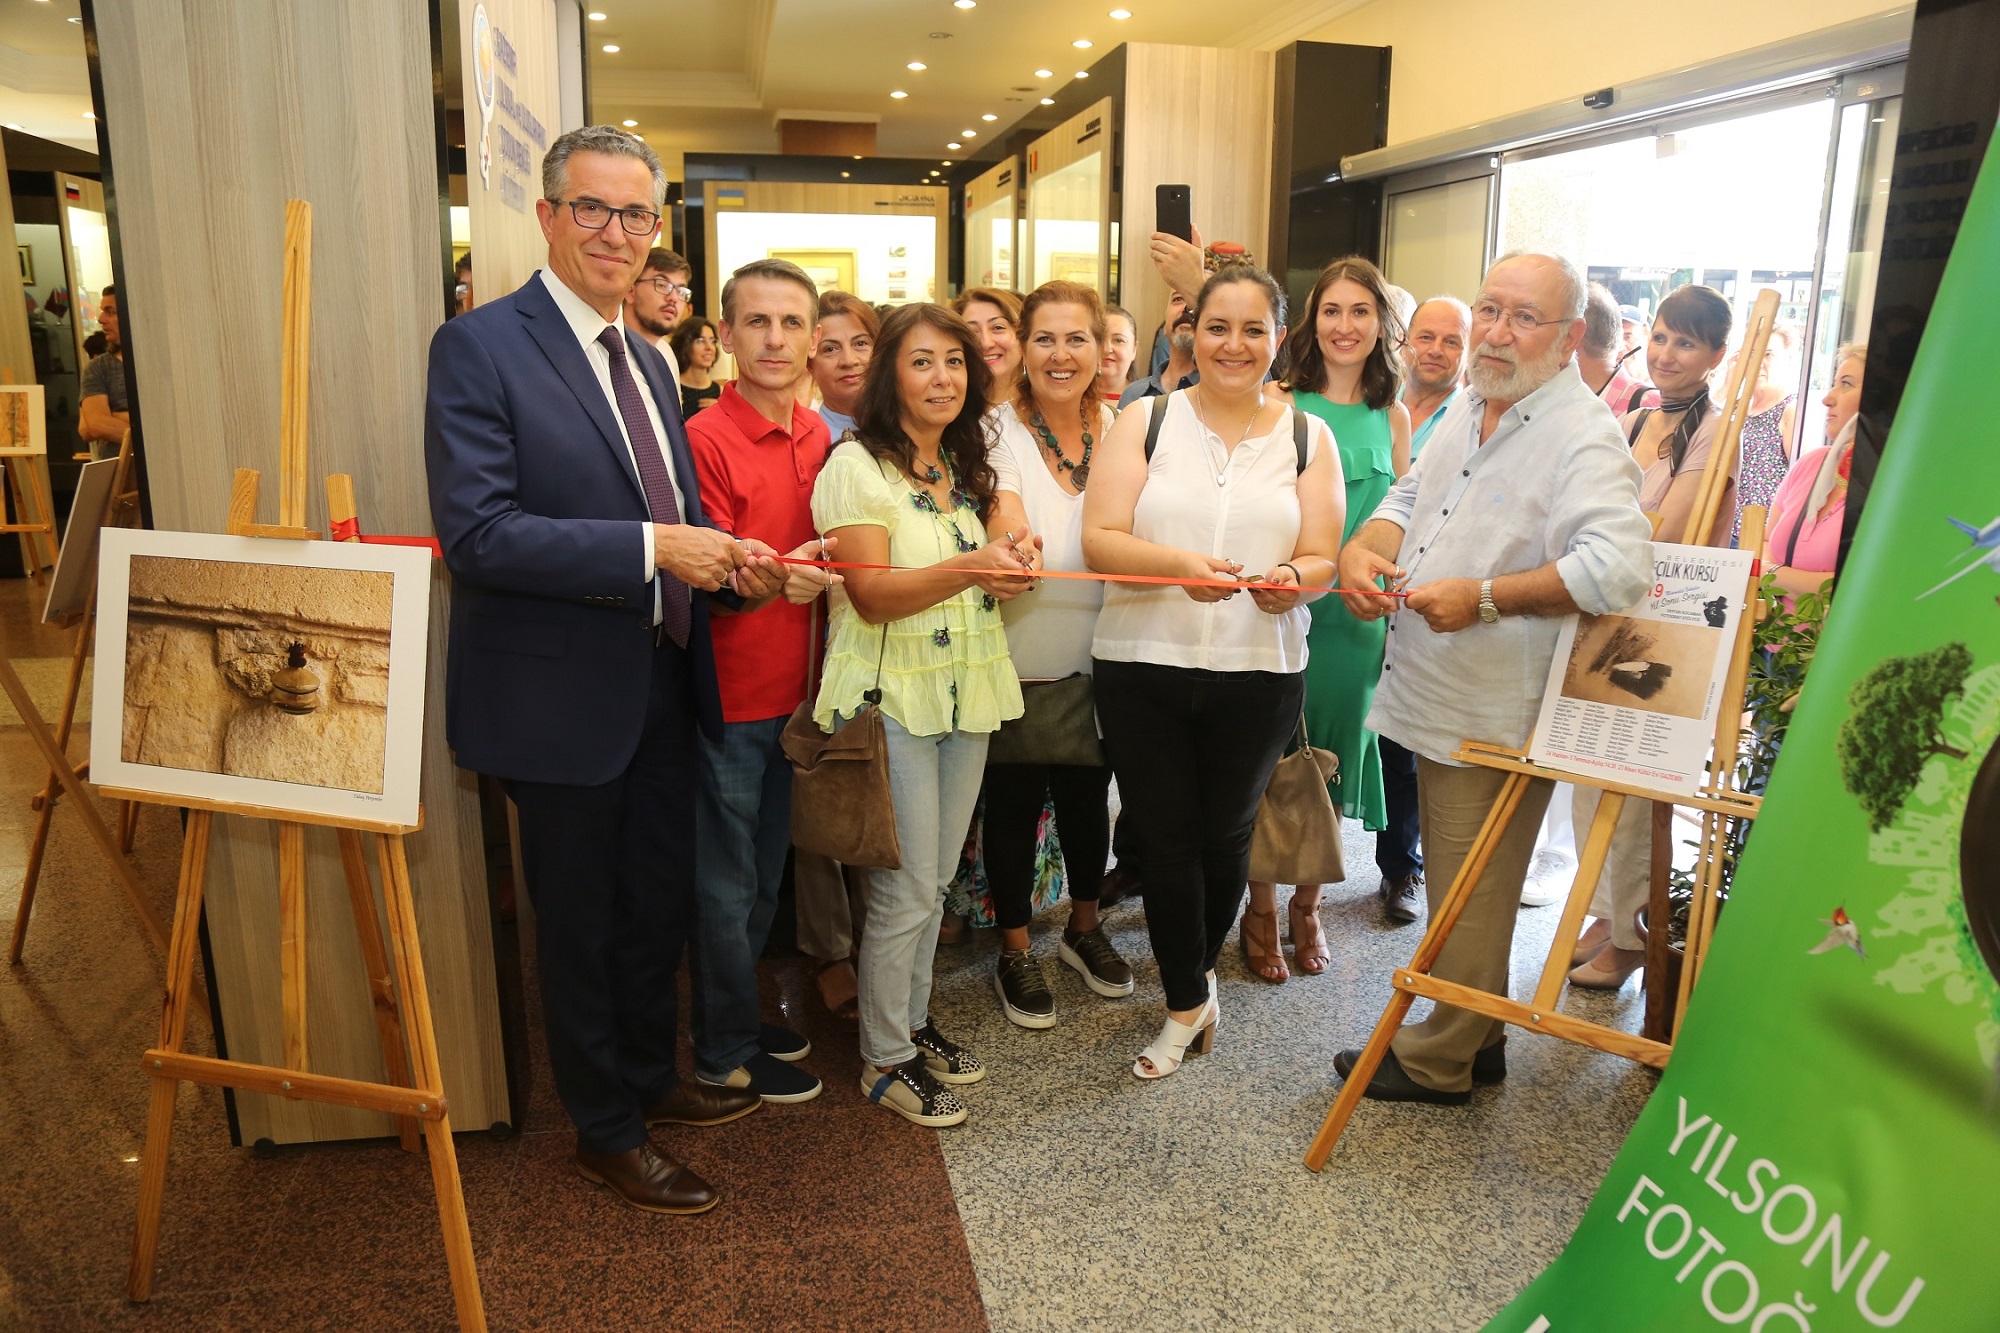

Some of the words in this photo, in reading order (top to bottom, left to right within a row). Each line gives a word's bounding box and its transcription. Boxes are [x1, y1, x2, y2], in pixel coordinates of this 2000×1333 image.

[1666, 555, 1743, 567] BELEDİYESİ
[1682, 562, 1720, 583] KURSU
[1660, 596, 1681, 608] Sonu
[1681, 592, 1709, 604] Sergisi
[1666, 1095, 1926, 1328] YILSONU
